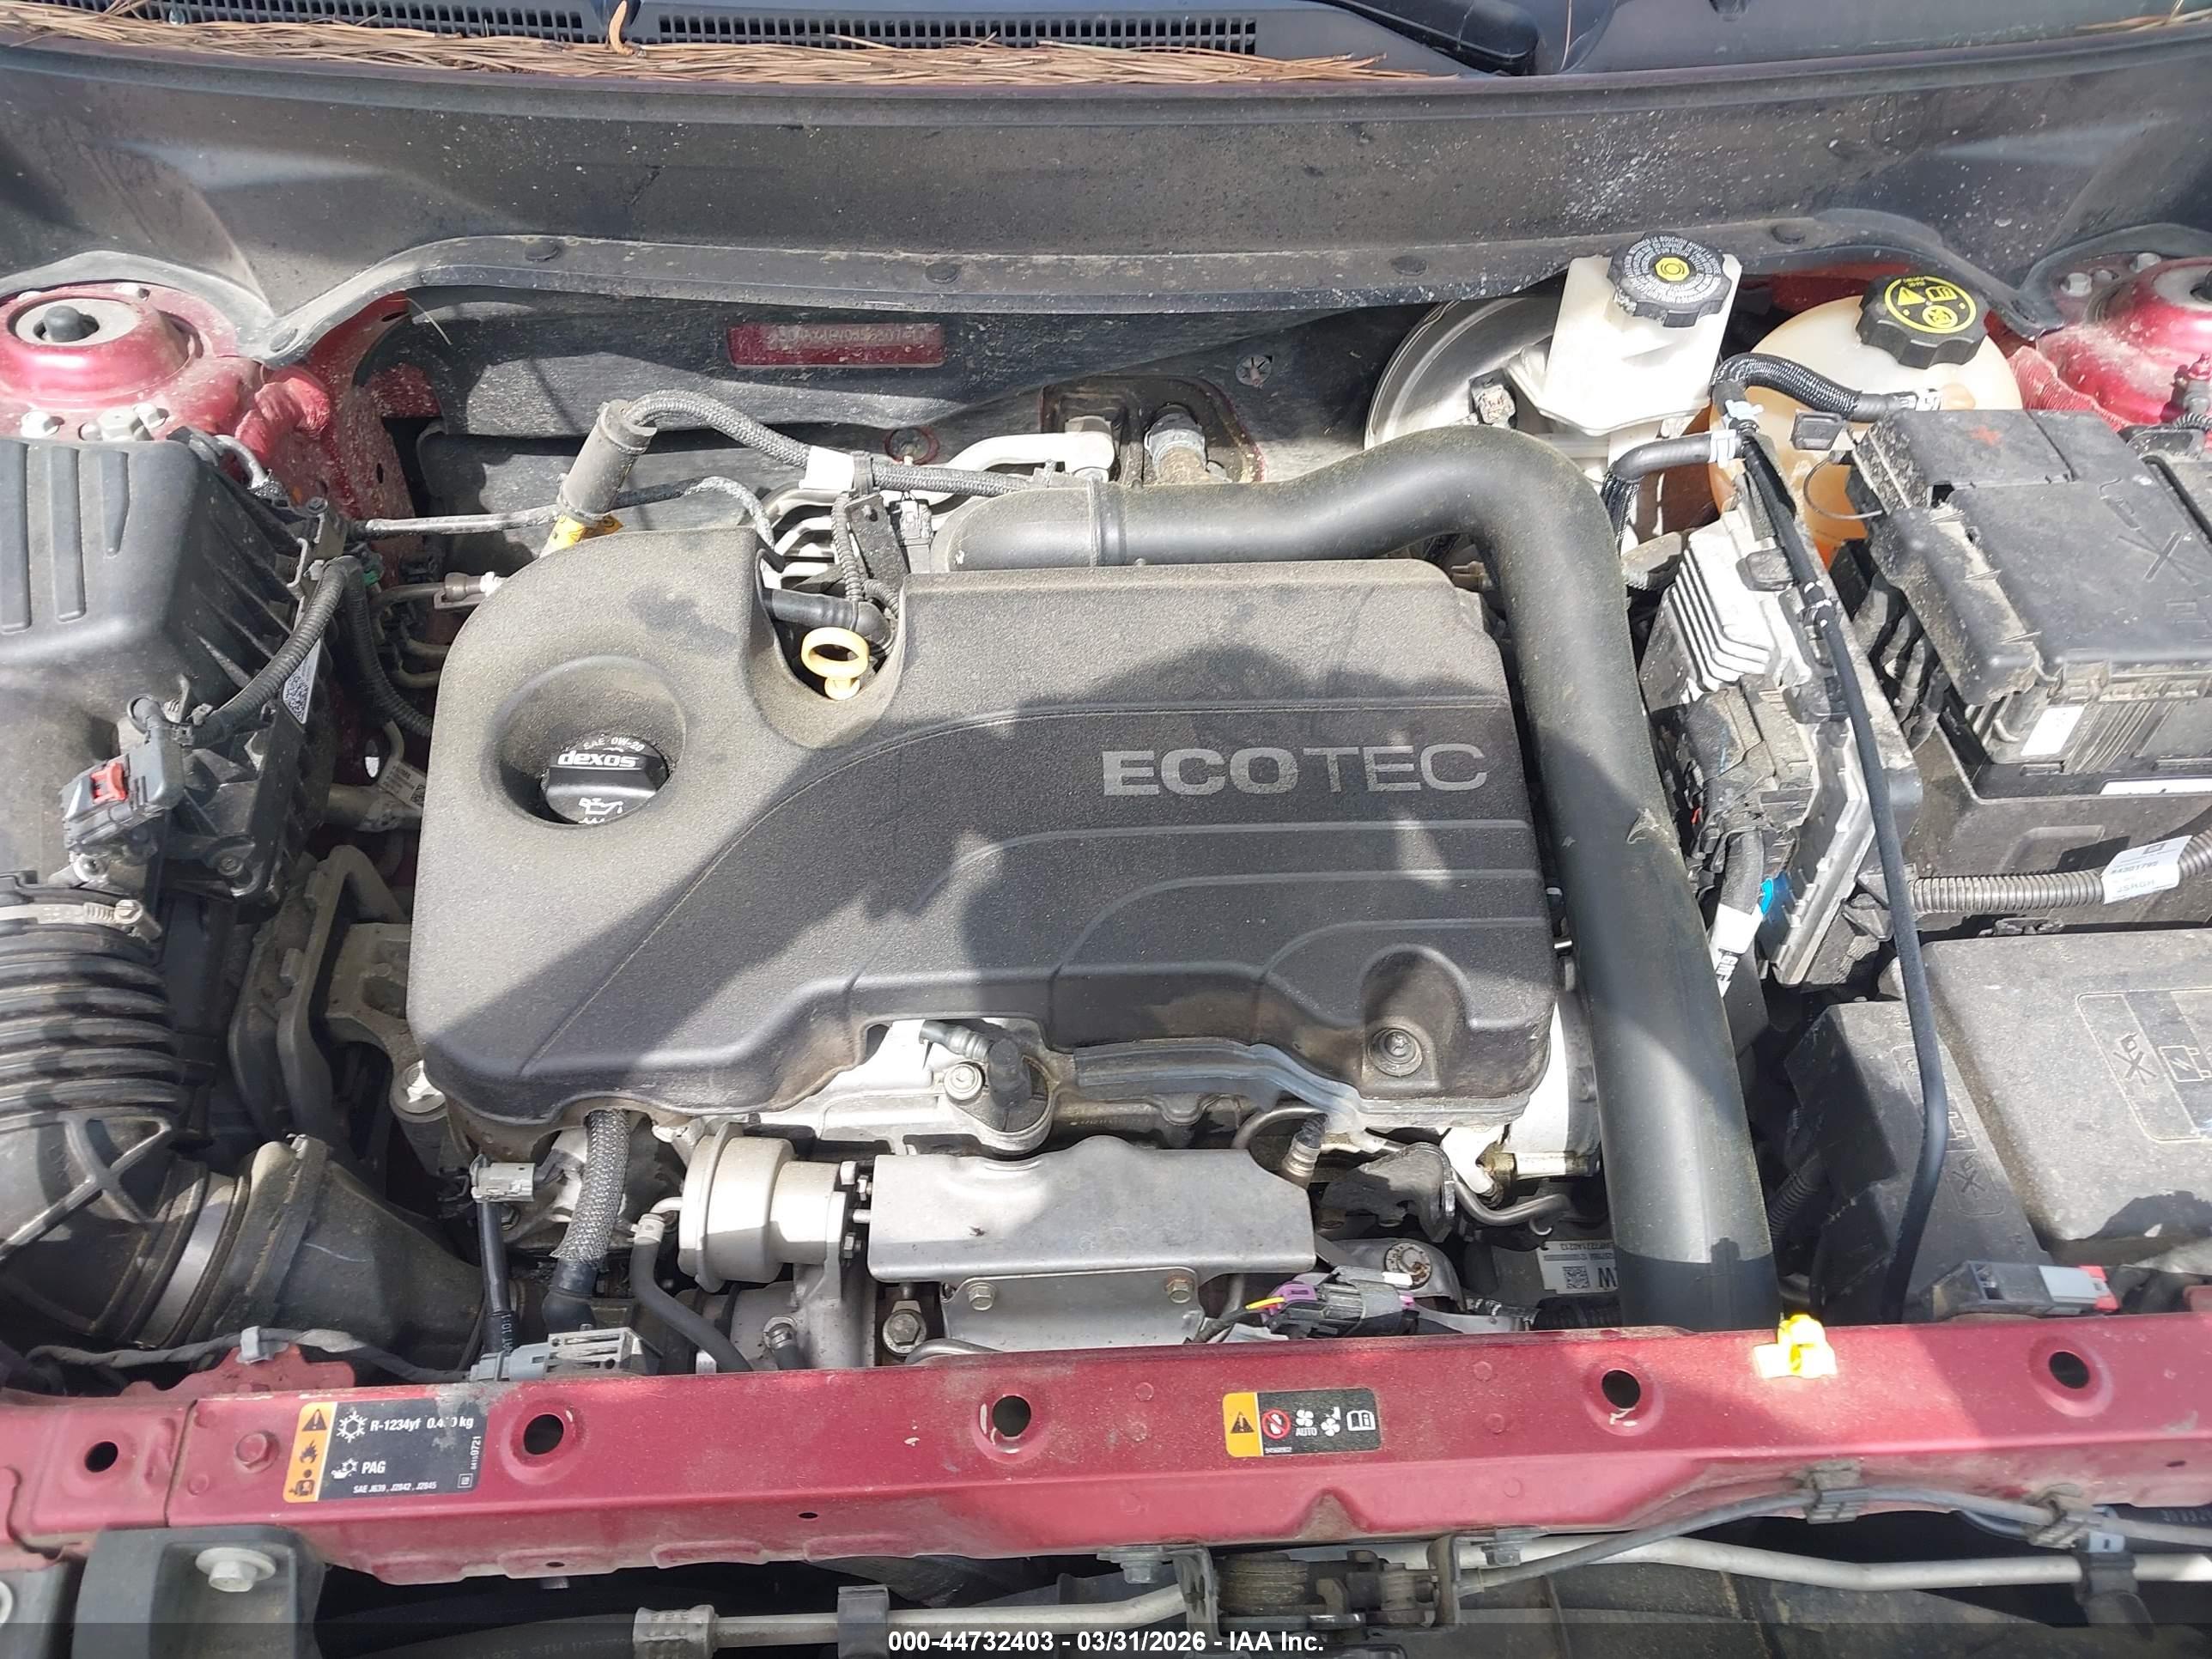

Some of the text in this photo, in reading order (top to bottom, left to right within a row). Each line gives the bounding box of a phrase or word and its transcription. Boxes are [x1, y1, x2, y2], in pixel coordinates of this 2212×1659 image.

[583, 736, 646, 752] SAE 0W-20
[557, 750, 640, 768] dexos
[1102, 743, 1488, 796] ECOTEC
[369, 1417, 421, 1432] R-1234yf
[459, 1415, 474, 1430] kg
[1295, 1426, 1318, 1437] AUTO
[361, 1460, 386, 1474] PAG
[353, 1484, 368, 1493] SAE
